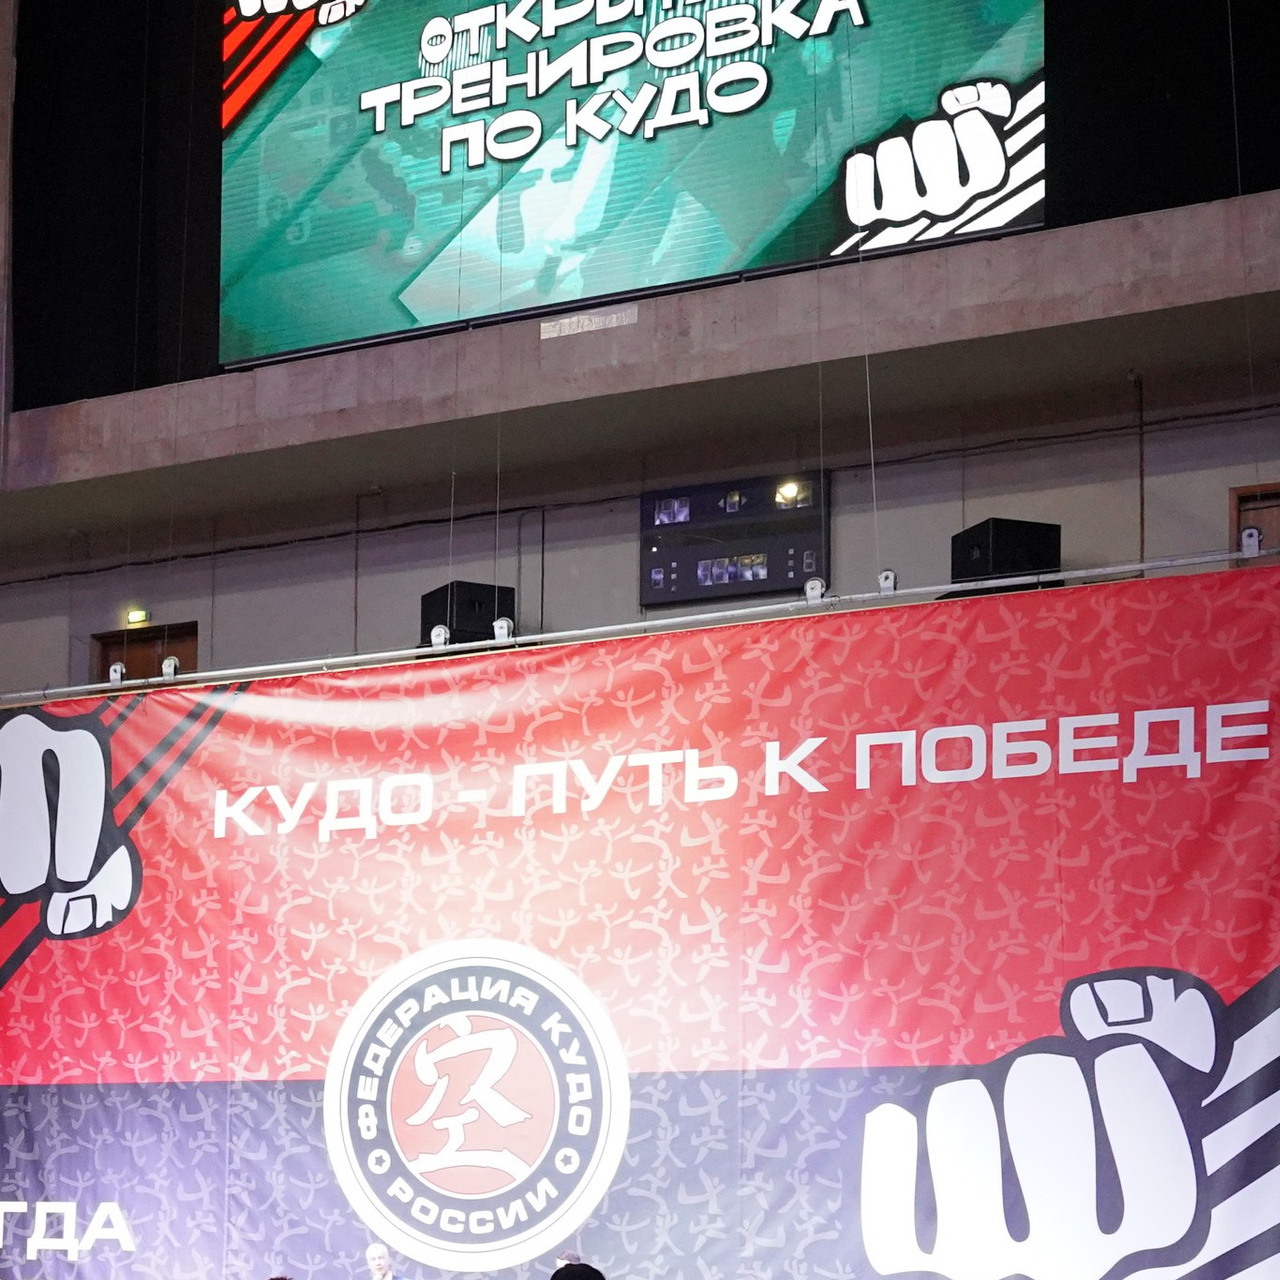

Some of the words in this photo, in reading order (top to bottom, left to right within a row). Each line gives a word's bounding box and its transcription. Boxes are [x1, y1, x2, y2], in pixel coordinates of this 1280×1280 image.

[360, 0, 866, 132] ТРЕНИРОВКА
[420, 0, 703, 64] ОТКРЫ
[441, 109, 542, 173] ПО
[565, 61, 768, 147] КУДО
[213, 772, 434, 843] КУДО
[512, 748, 739, 817] ПУТЬ
[764, 736, 830, 796] К
[855, 699, 1270, 790] ПОБЕДЕ
[356, 975, 540, 1140] ФЕДЕРАЦИЯ
[540, 1011, 593, 1137] КУДО
[386, 1176, 559, 1235] РОССИИ
